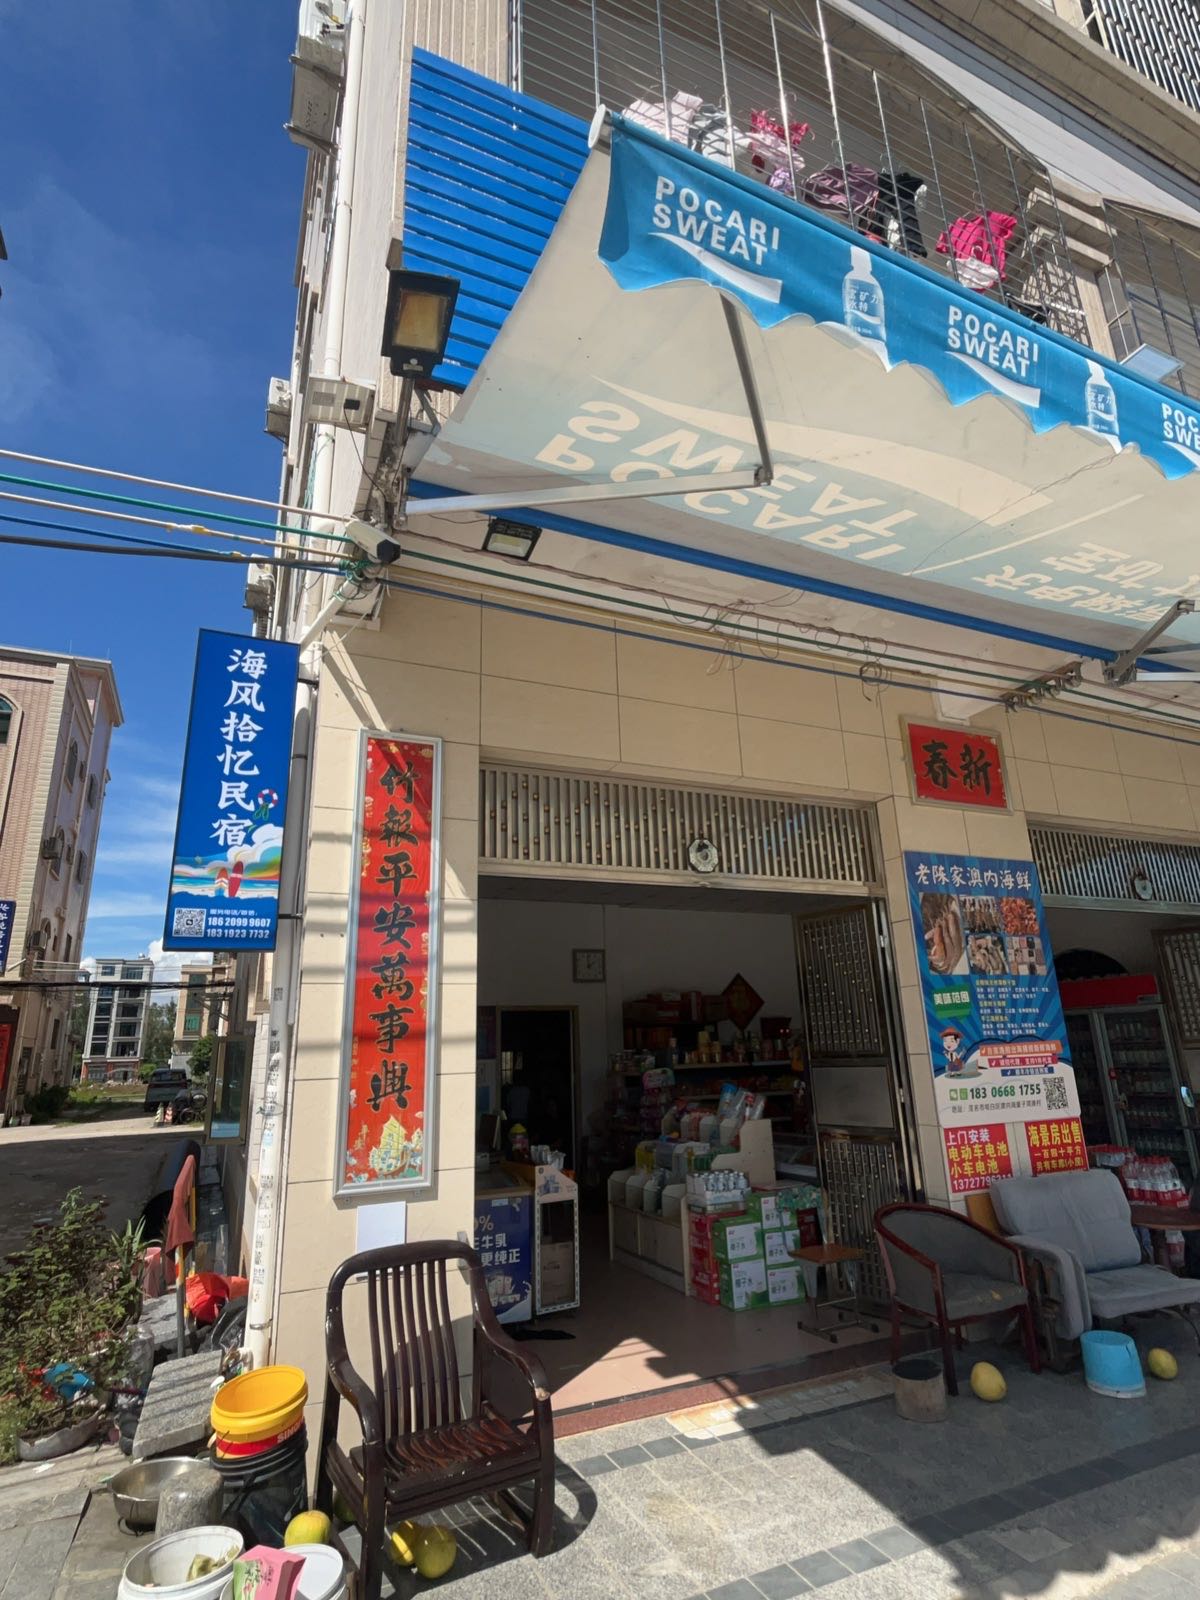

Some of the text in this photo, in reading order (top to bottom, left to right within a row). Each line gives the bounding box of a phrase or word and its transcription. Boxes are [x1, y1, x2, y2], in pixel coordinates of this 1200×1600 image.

[655, 175, 780, 251] POCARI
[652, 203, 768, 266] SWEAT
[948, 305, 1039, 362] POCARI
[947, 327, 1030, 377] SWEAT
[209, 648, 268, 847] 海风拾忆民宿
[914, 863, 1031, 891] 老陈家澳内海鲜
[206, 929, 270, 939] 183 1923 7732
[208, 917, 271, 928] 186 2099 9607
[969, 1083, 1041, 1100] 183 0668 1755
[946, 1128, 990, 1146] 上门安装
[1028, 1121, 1082, 1148] 海景房出售
[948, 1141, 1009, 1162] 电动车电池
[950, 1159, 1000, 1179] 小车电池
[481, 1248, 520, 1267] 更纯正
